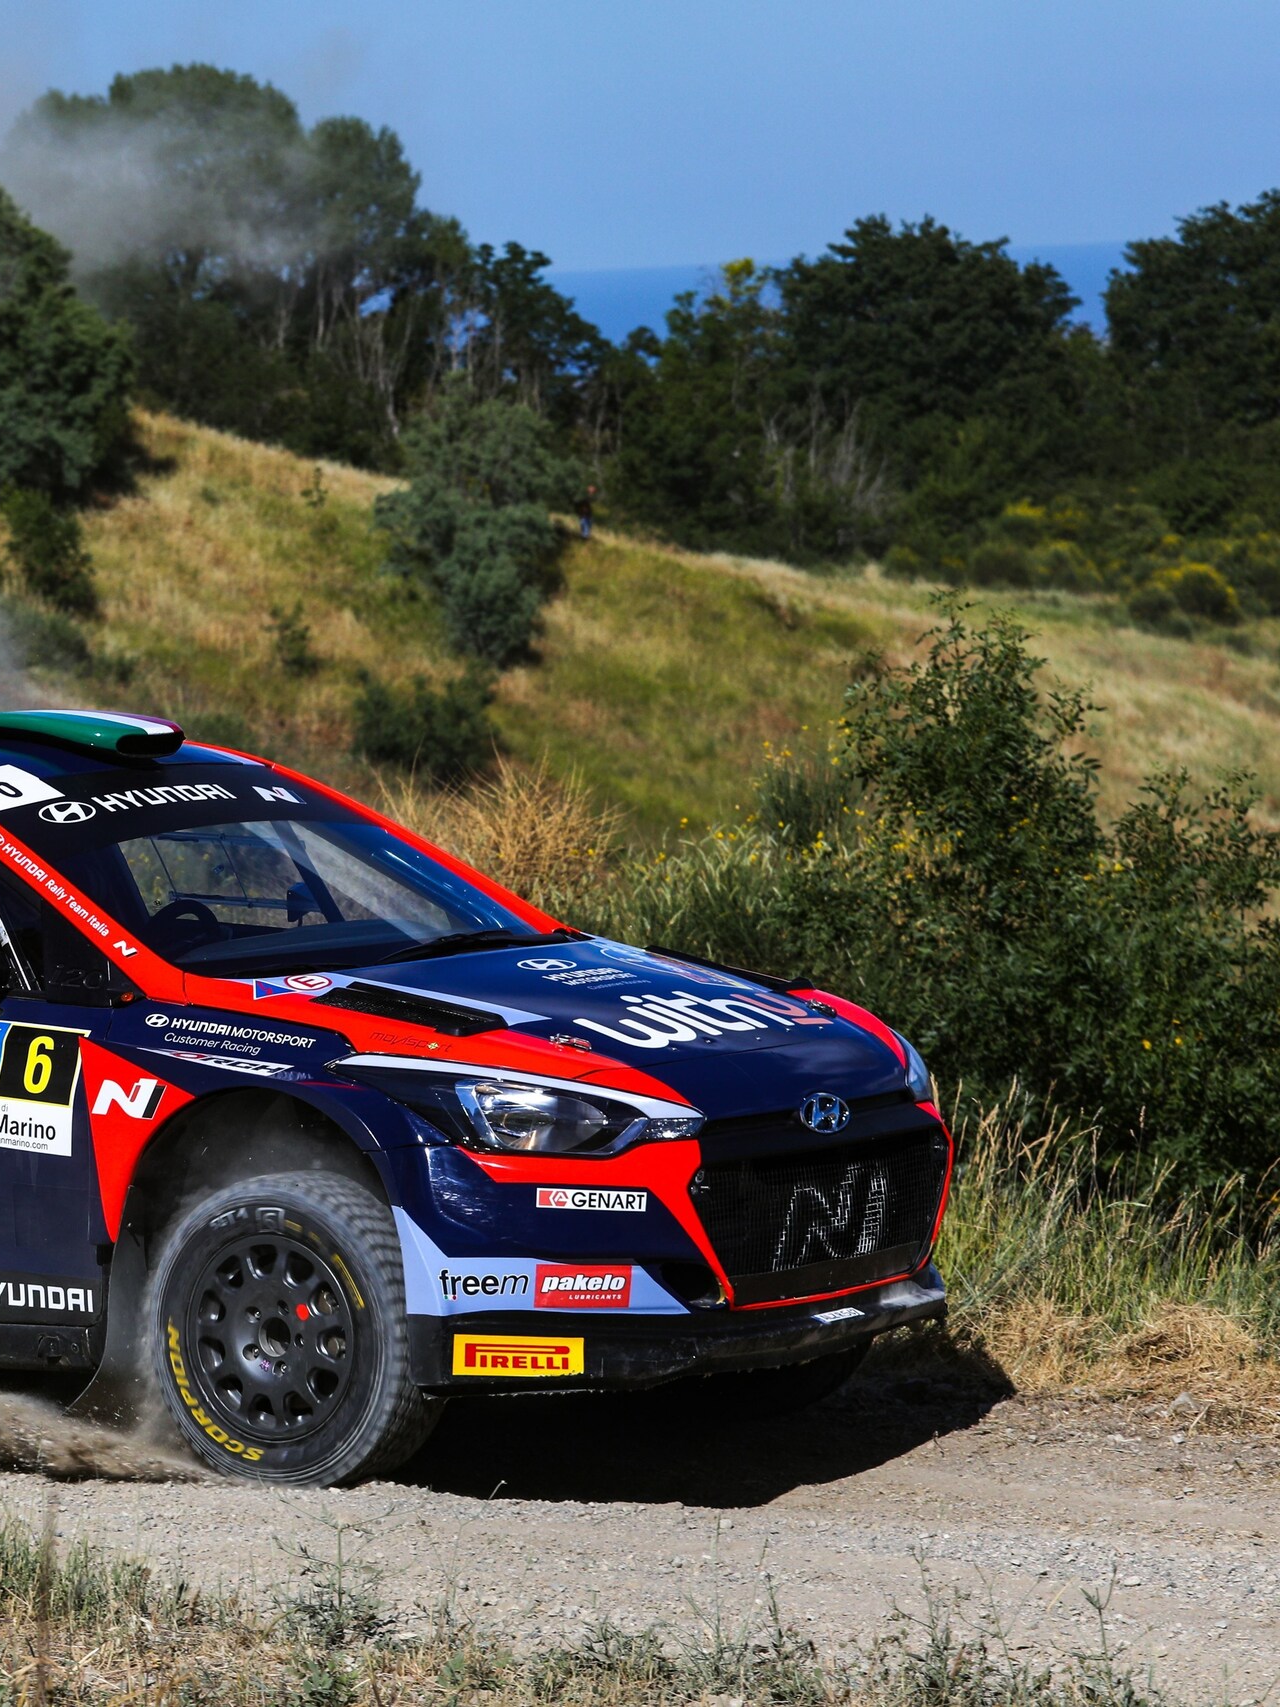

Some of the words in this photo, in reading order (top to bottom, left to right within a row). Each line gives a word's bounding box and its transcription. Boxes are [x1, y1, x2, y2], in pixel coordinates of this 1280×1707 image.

[91, 783, 238, 813] HYUNDAI
[2, 843, 49, 882] HYUNDAI
[45, 878, 68, 900] Rally
[65, 895, 89, 919] Team
[86, 914, 110, 937] Italia
[291, 976, 321, 988] E
[164, 1032, 220, 1048] Customer
[220, 1039, 261, 1056] Racing
[170, 1017, 231, 1036] HYUNDAI
[230, 1027, 316, 1049] MOTORSPORT
[370, 1030, 454, 1053] movisport
[23, 1035, 55, 1094] 6
[1, 1103, 9, 1112] di
[571, 1191, 645, 1210] GENART
[438, 1268, 529, 1300] freem
[540, 1273, 626, 1294] pakelo
[464, 1343, 570, 1370] PIRELLI
[167, 1316, 264, 1462] SCORPION
